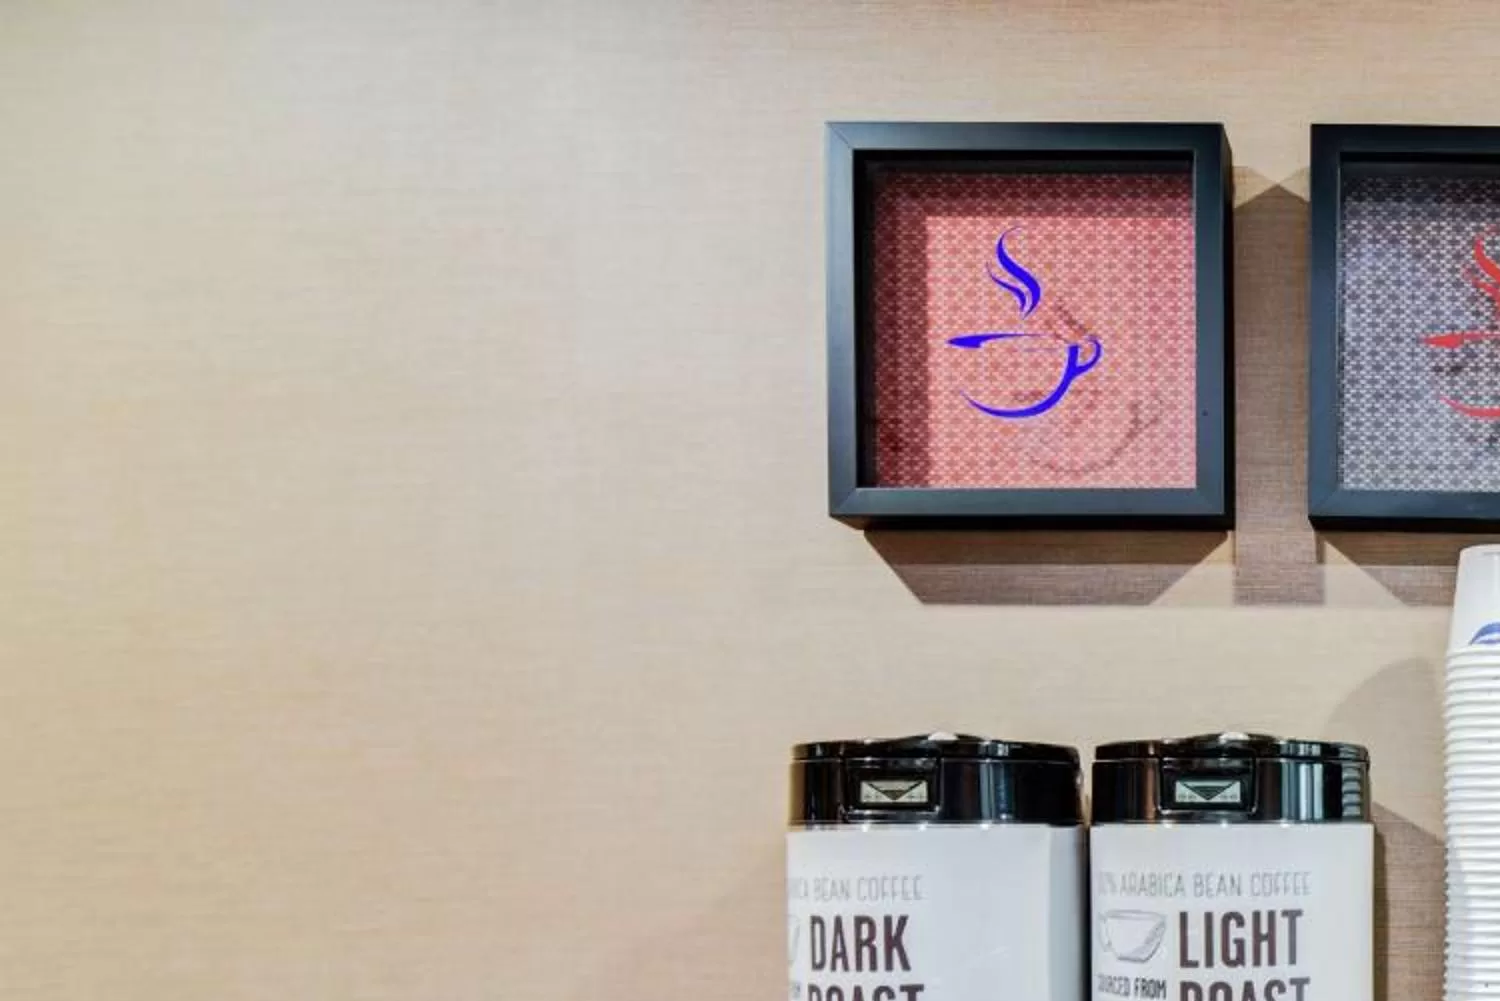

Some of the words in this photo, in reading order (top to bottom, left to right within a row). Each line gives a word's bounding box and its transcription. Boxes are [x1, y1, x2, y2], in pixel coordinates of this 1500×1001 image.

[858, 874, 924, 901] COFFEE
[1193, 871, 1242, 898] BEAN
[1250, 870, 1313, 897] COFFEE
[809, 914, 912, 972] DARK
[1179, 909, 1304, 968] LIGHT
[1133, 977, 1167, 1000] FROM
